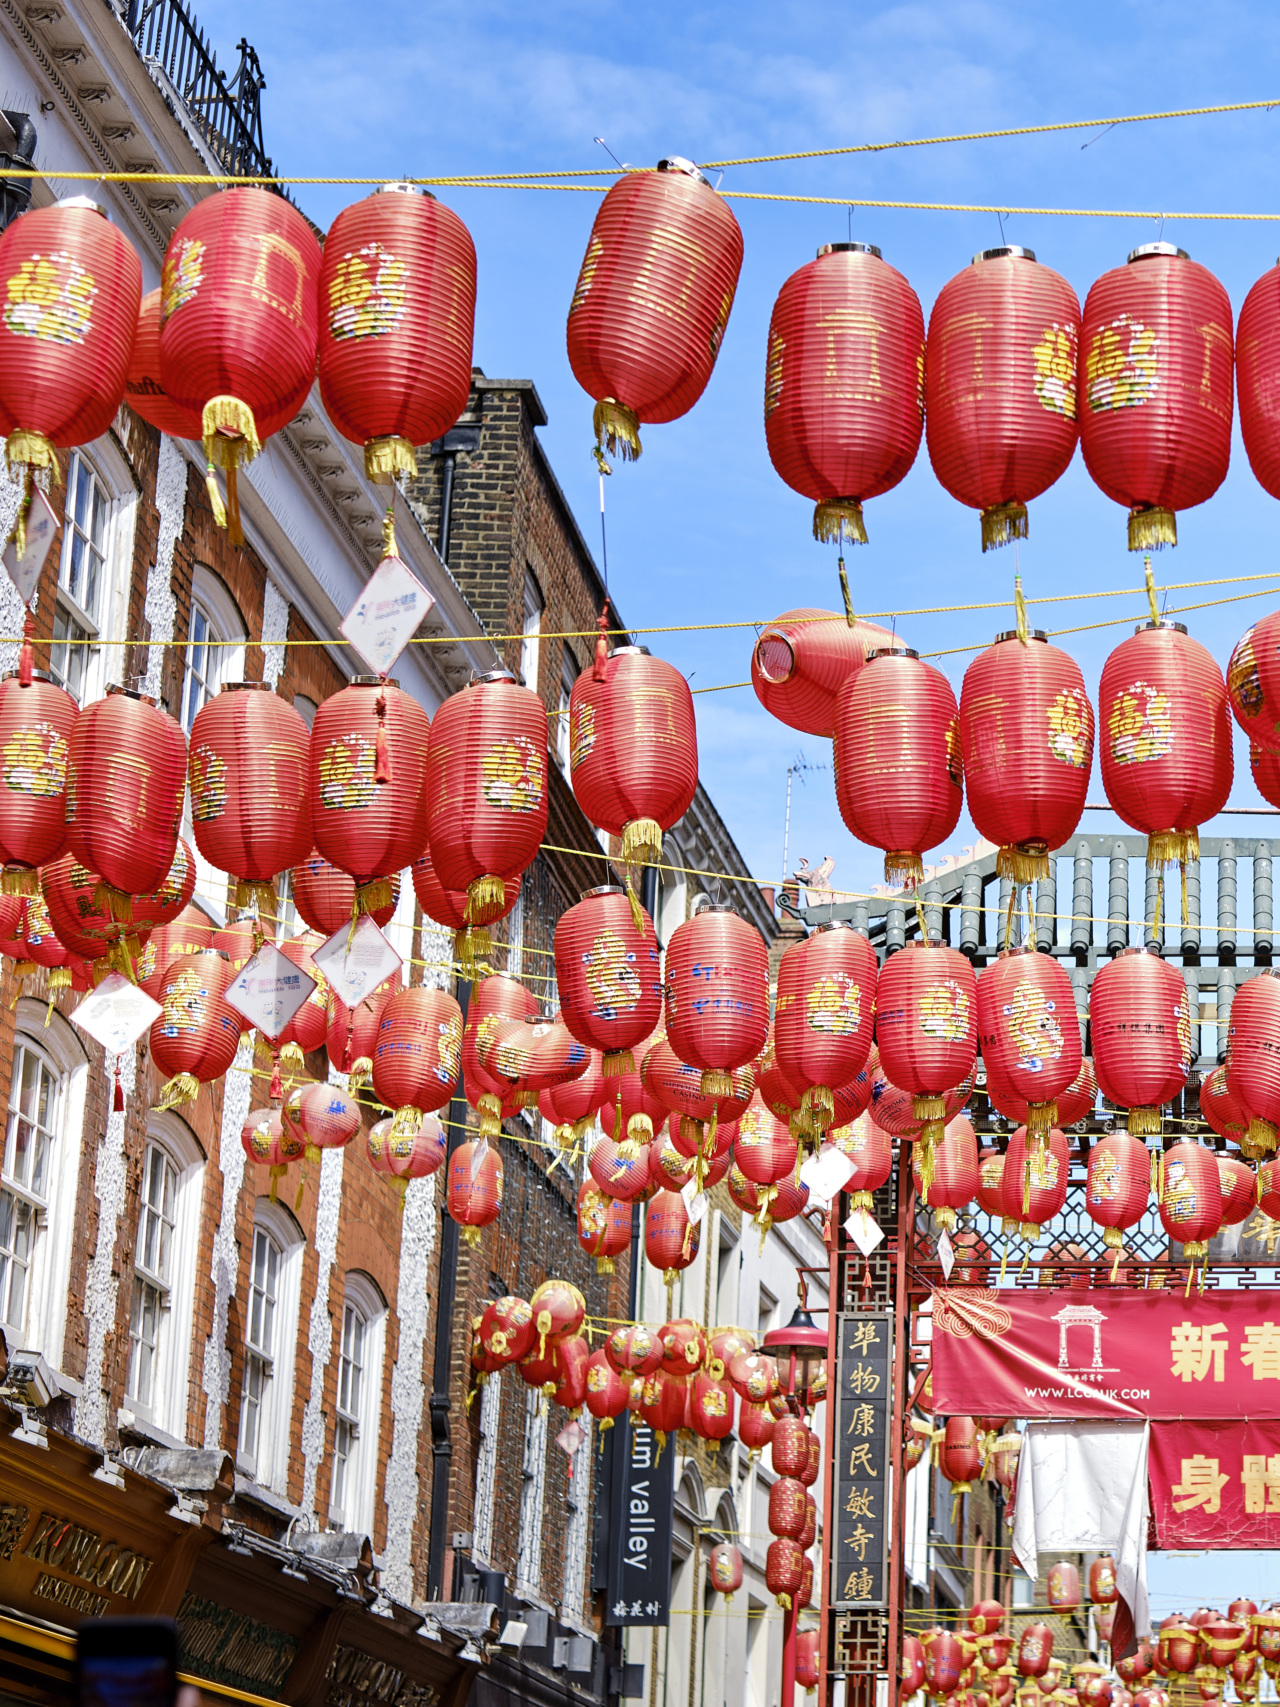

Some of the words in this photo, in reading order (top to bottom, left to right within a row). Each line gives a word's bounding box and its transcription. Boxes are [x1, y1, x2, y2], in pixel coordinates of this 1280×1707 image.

[673, 1089, 706, 1103] CASINO
[843, 1321, 881, 1601] 埠物康民敏寺鐘
[23, 1512, 154, 1600] KOWLOON
[623, 1480, 656, 1570] valley
[33, 1572, 112, 1618] RESTAURANT
